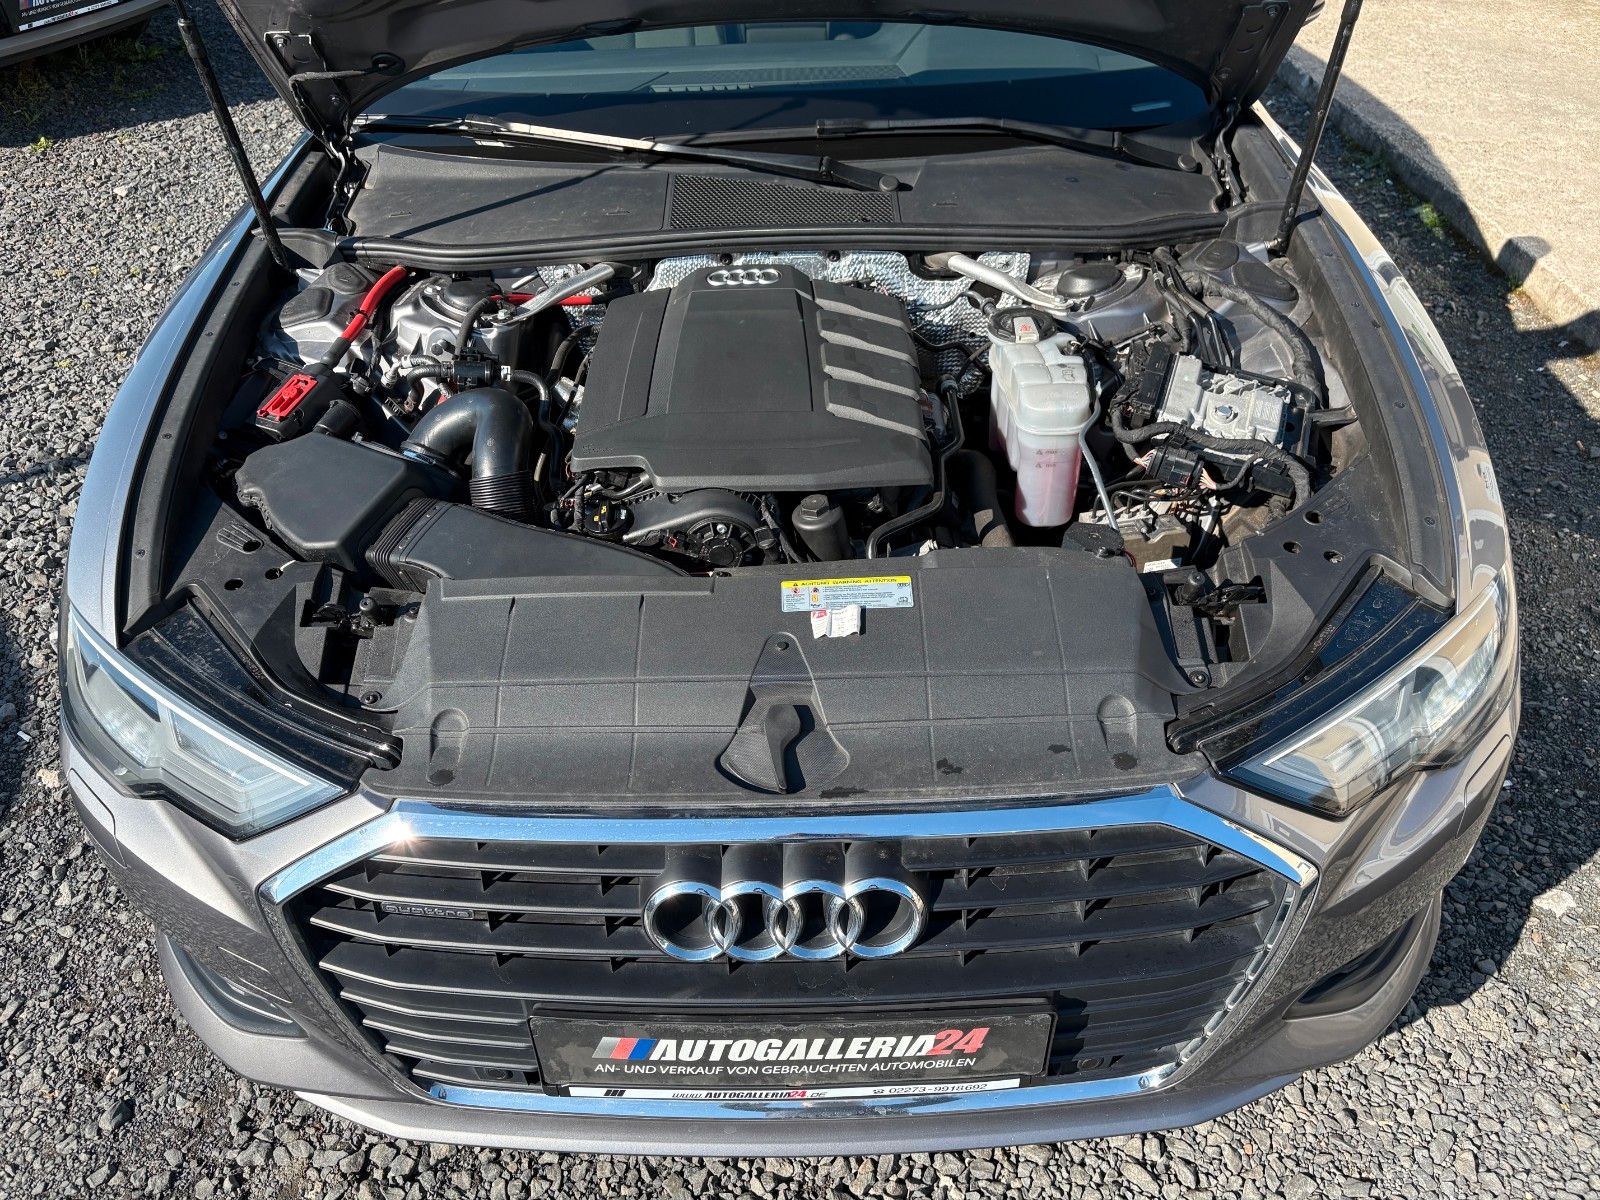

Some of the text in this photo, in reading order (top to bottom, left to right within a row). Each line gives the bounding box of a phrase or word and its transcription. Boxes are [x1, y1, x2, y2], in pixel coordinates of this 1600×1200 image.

[385, 905, 469, 918] quattro
[594, 1057, 977, 1075] AN- UND VERKAUF VON GEBRAUCHTEN AUTOMOBILEN
[888, 1083, 988, 1094] 02273-9918692
